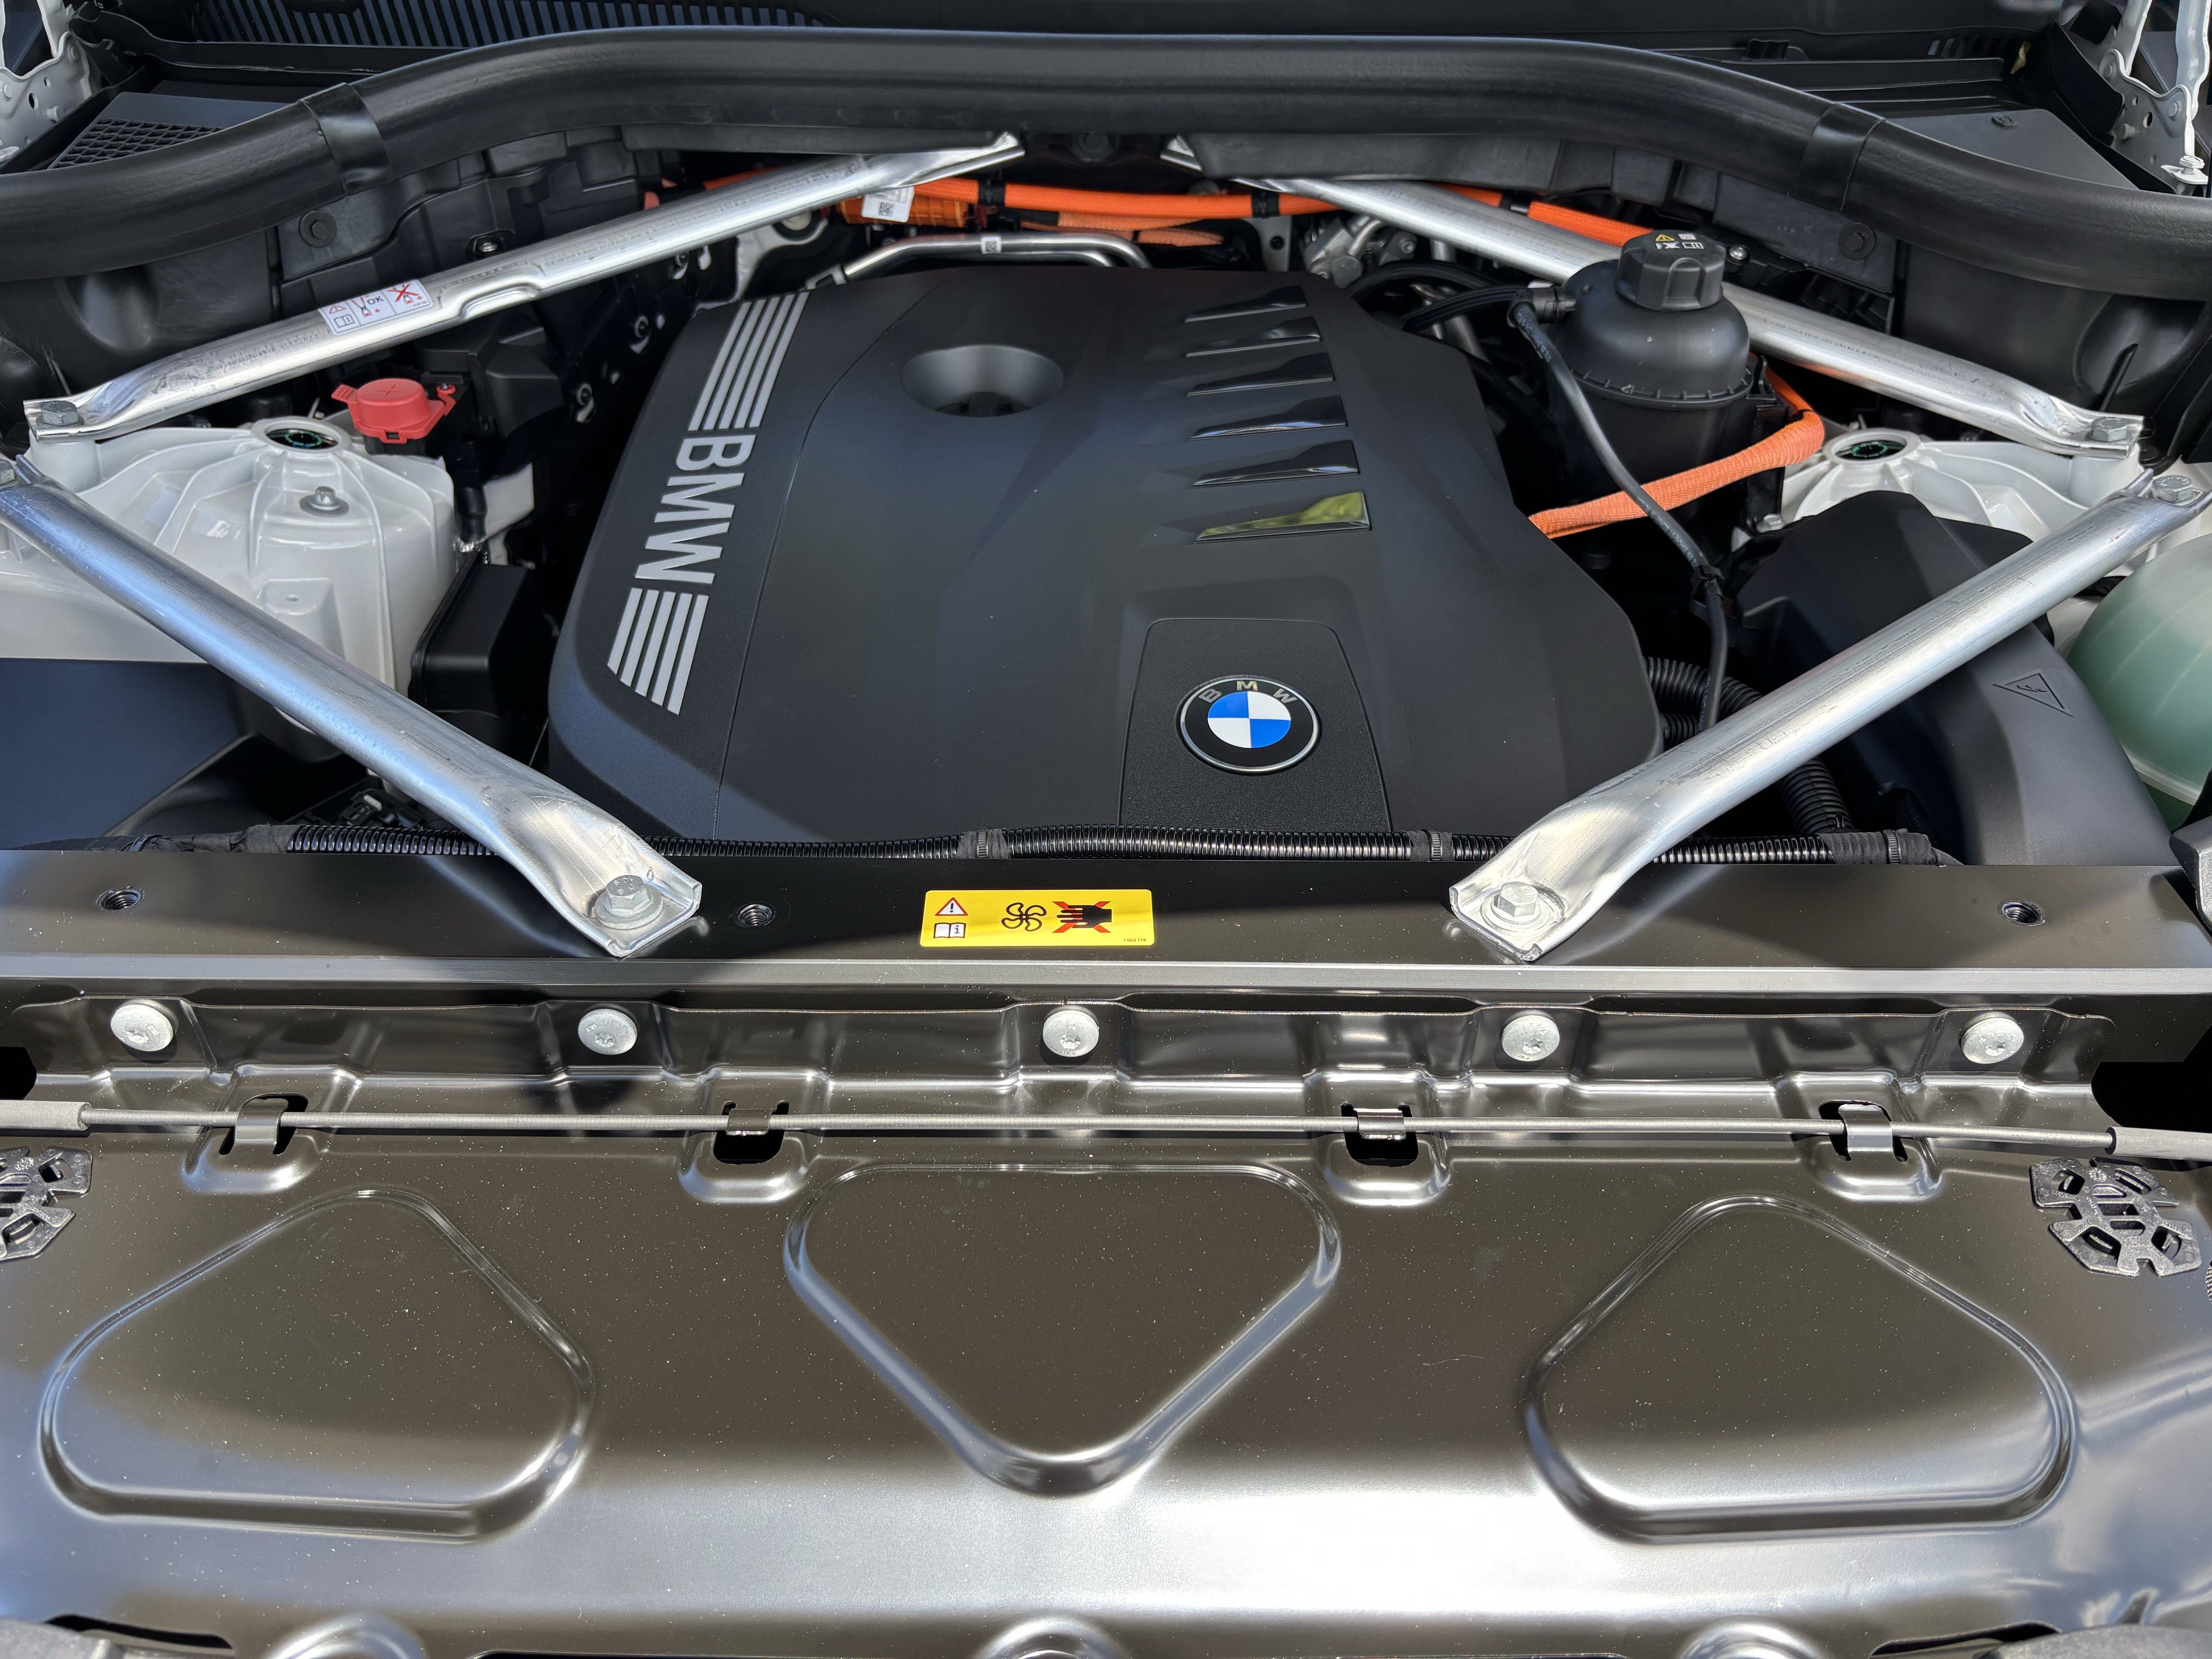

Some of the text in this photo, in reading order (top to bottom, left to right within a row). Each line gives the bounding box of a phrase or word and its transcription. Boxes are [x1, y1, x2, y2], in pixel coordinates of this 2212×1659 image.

[367, 295, 384, 305] OK
[635, 434, 756, 584] BMW
[1199, 681, 1297, 703] BMW
